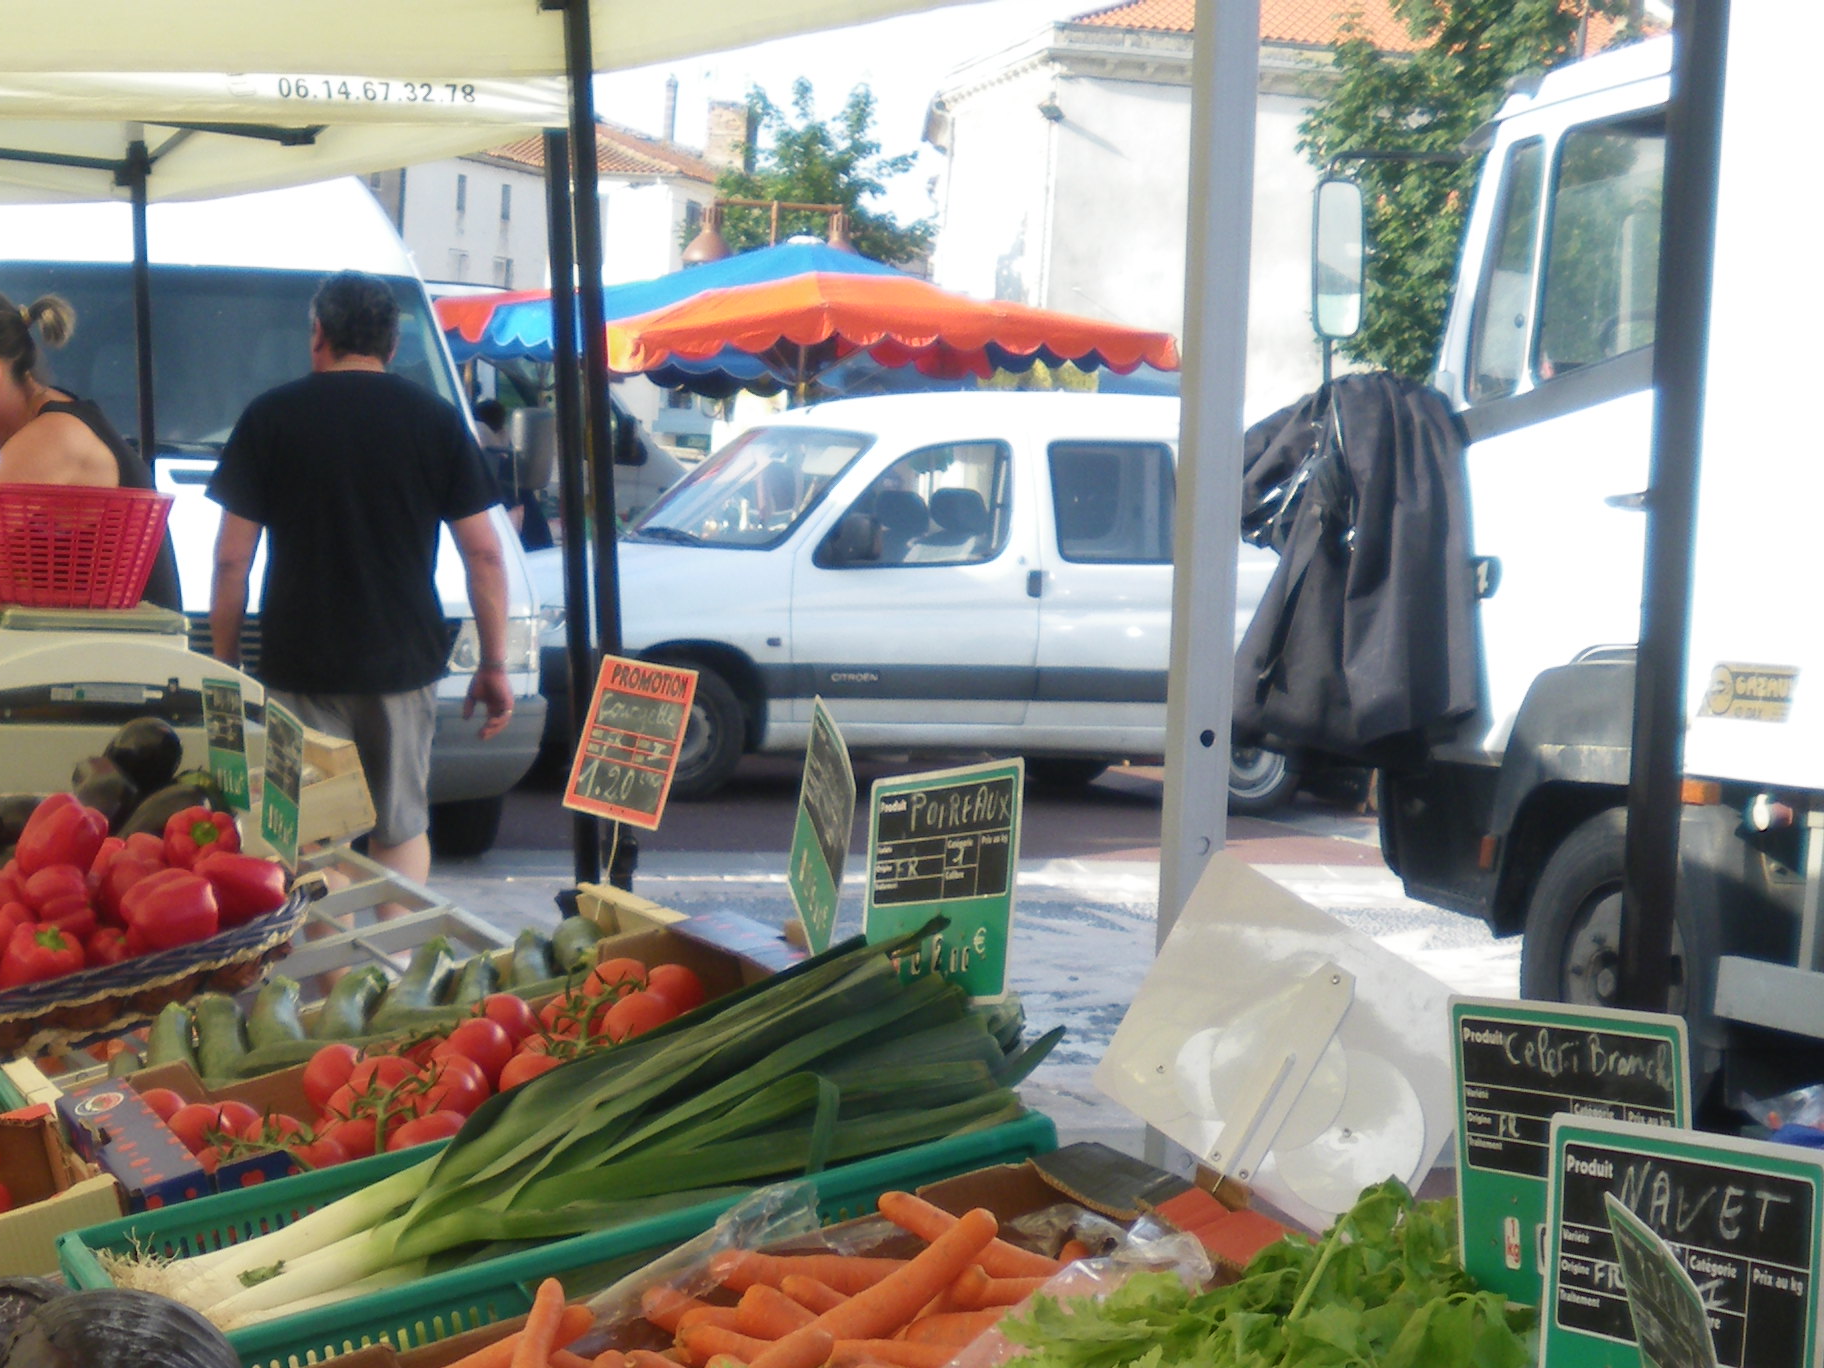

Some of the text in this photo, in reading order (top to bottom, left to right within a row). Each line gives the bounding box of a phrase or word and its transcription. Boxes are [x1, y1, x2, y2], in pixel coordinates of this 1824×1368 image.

[278, 77, 476, 102] 06.14.67.32.78
[610, 663, 689, 699] PROMOTION
[911, 785, 1011, 832] POIREAUX
[1463, 1027, 1504, 1046] Produit
[1565, 1154, 1614, 1180] Produit
[1619, 1160, 1791, 1240] NAVET
[1689, 1255, 1737, 1279] Catégorie
[1752, 1268, 1804, 1295] Prix au kg
